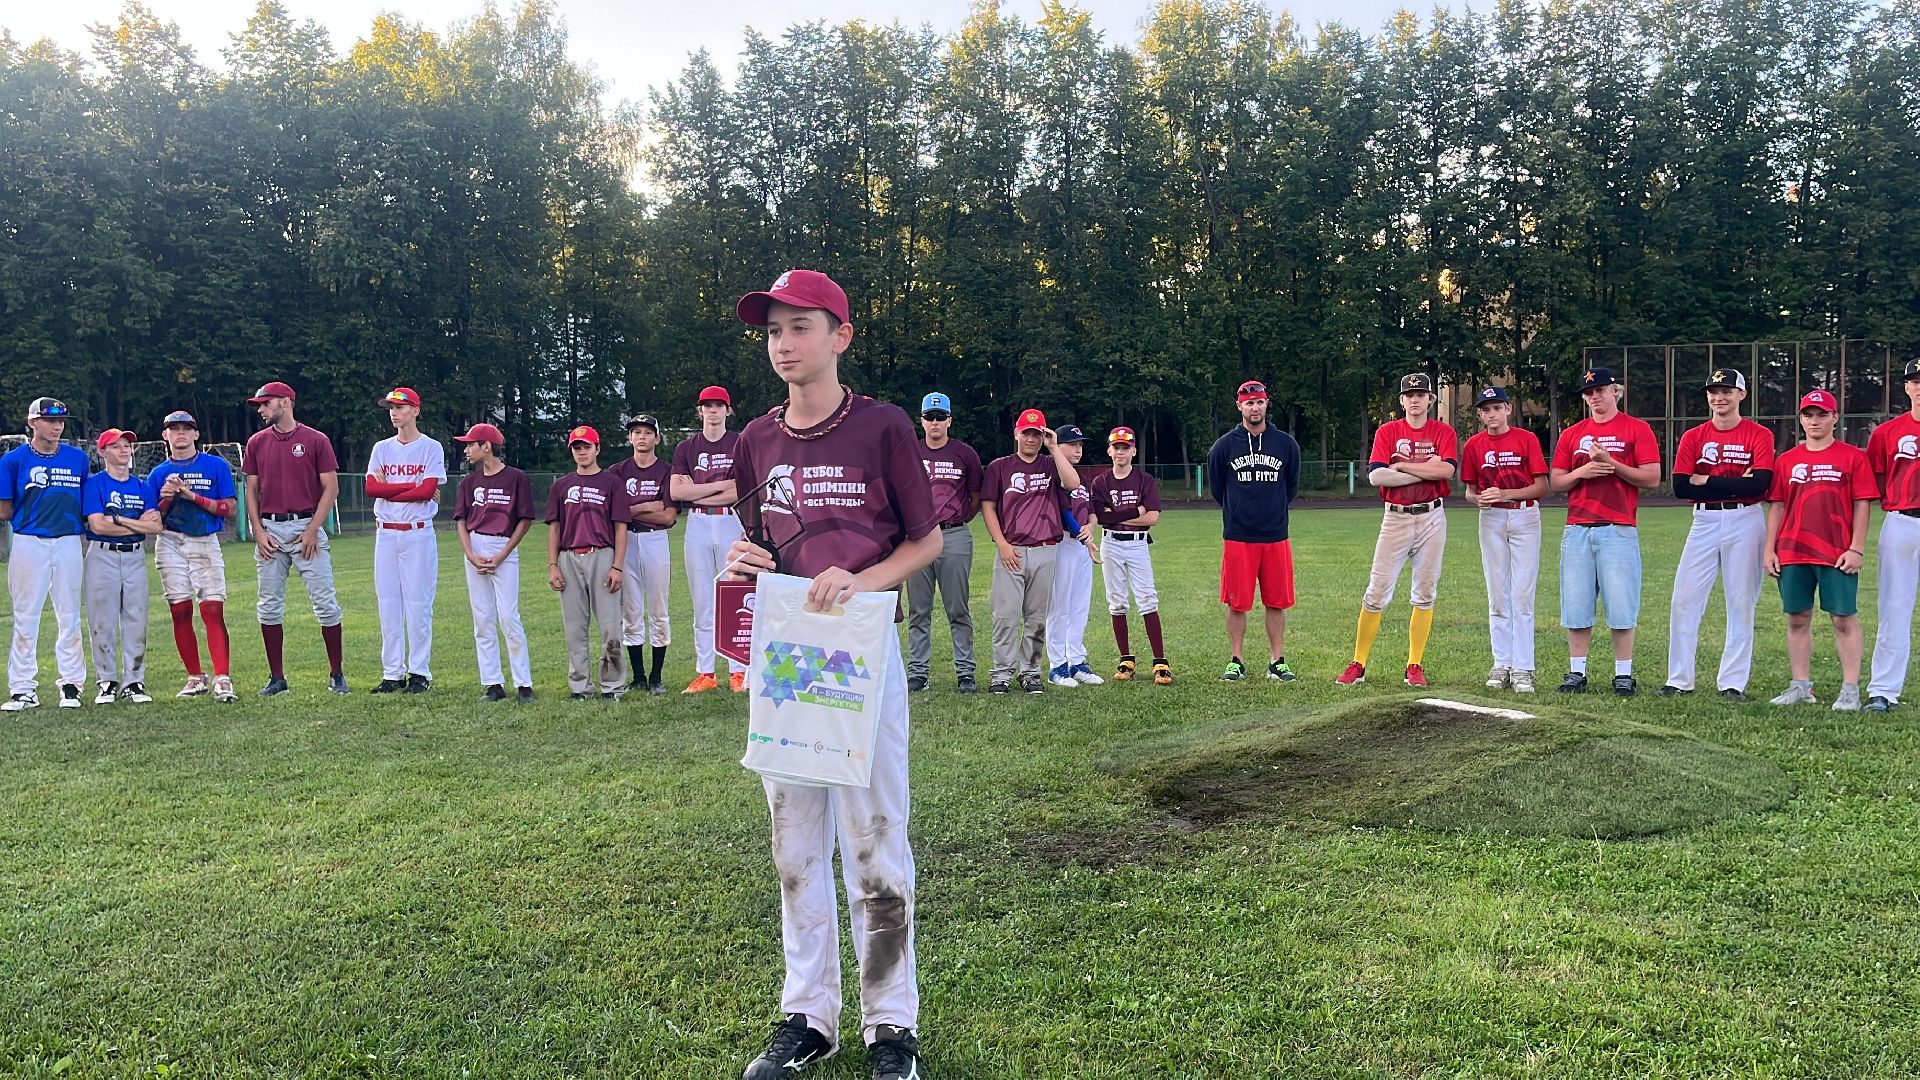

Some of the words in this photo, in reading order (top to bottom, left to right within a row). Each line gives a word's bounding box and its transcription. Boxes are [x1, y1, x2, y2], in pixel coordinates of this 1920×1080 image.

[802, 465, 844, 478] КУБОК
[1237, 471, 1252, 482] AND
[1255, 470, 1279, 482] FITCH
[802, 481, 866, 494] ОЛИМПИИ
[803, 498, 824, 507] «ВСЕ
[824, 497, 866, 507] ЗВЕЗДЫ»
